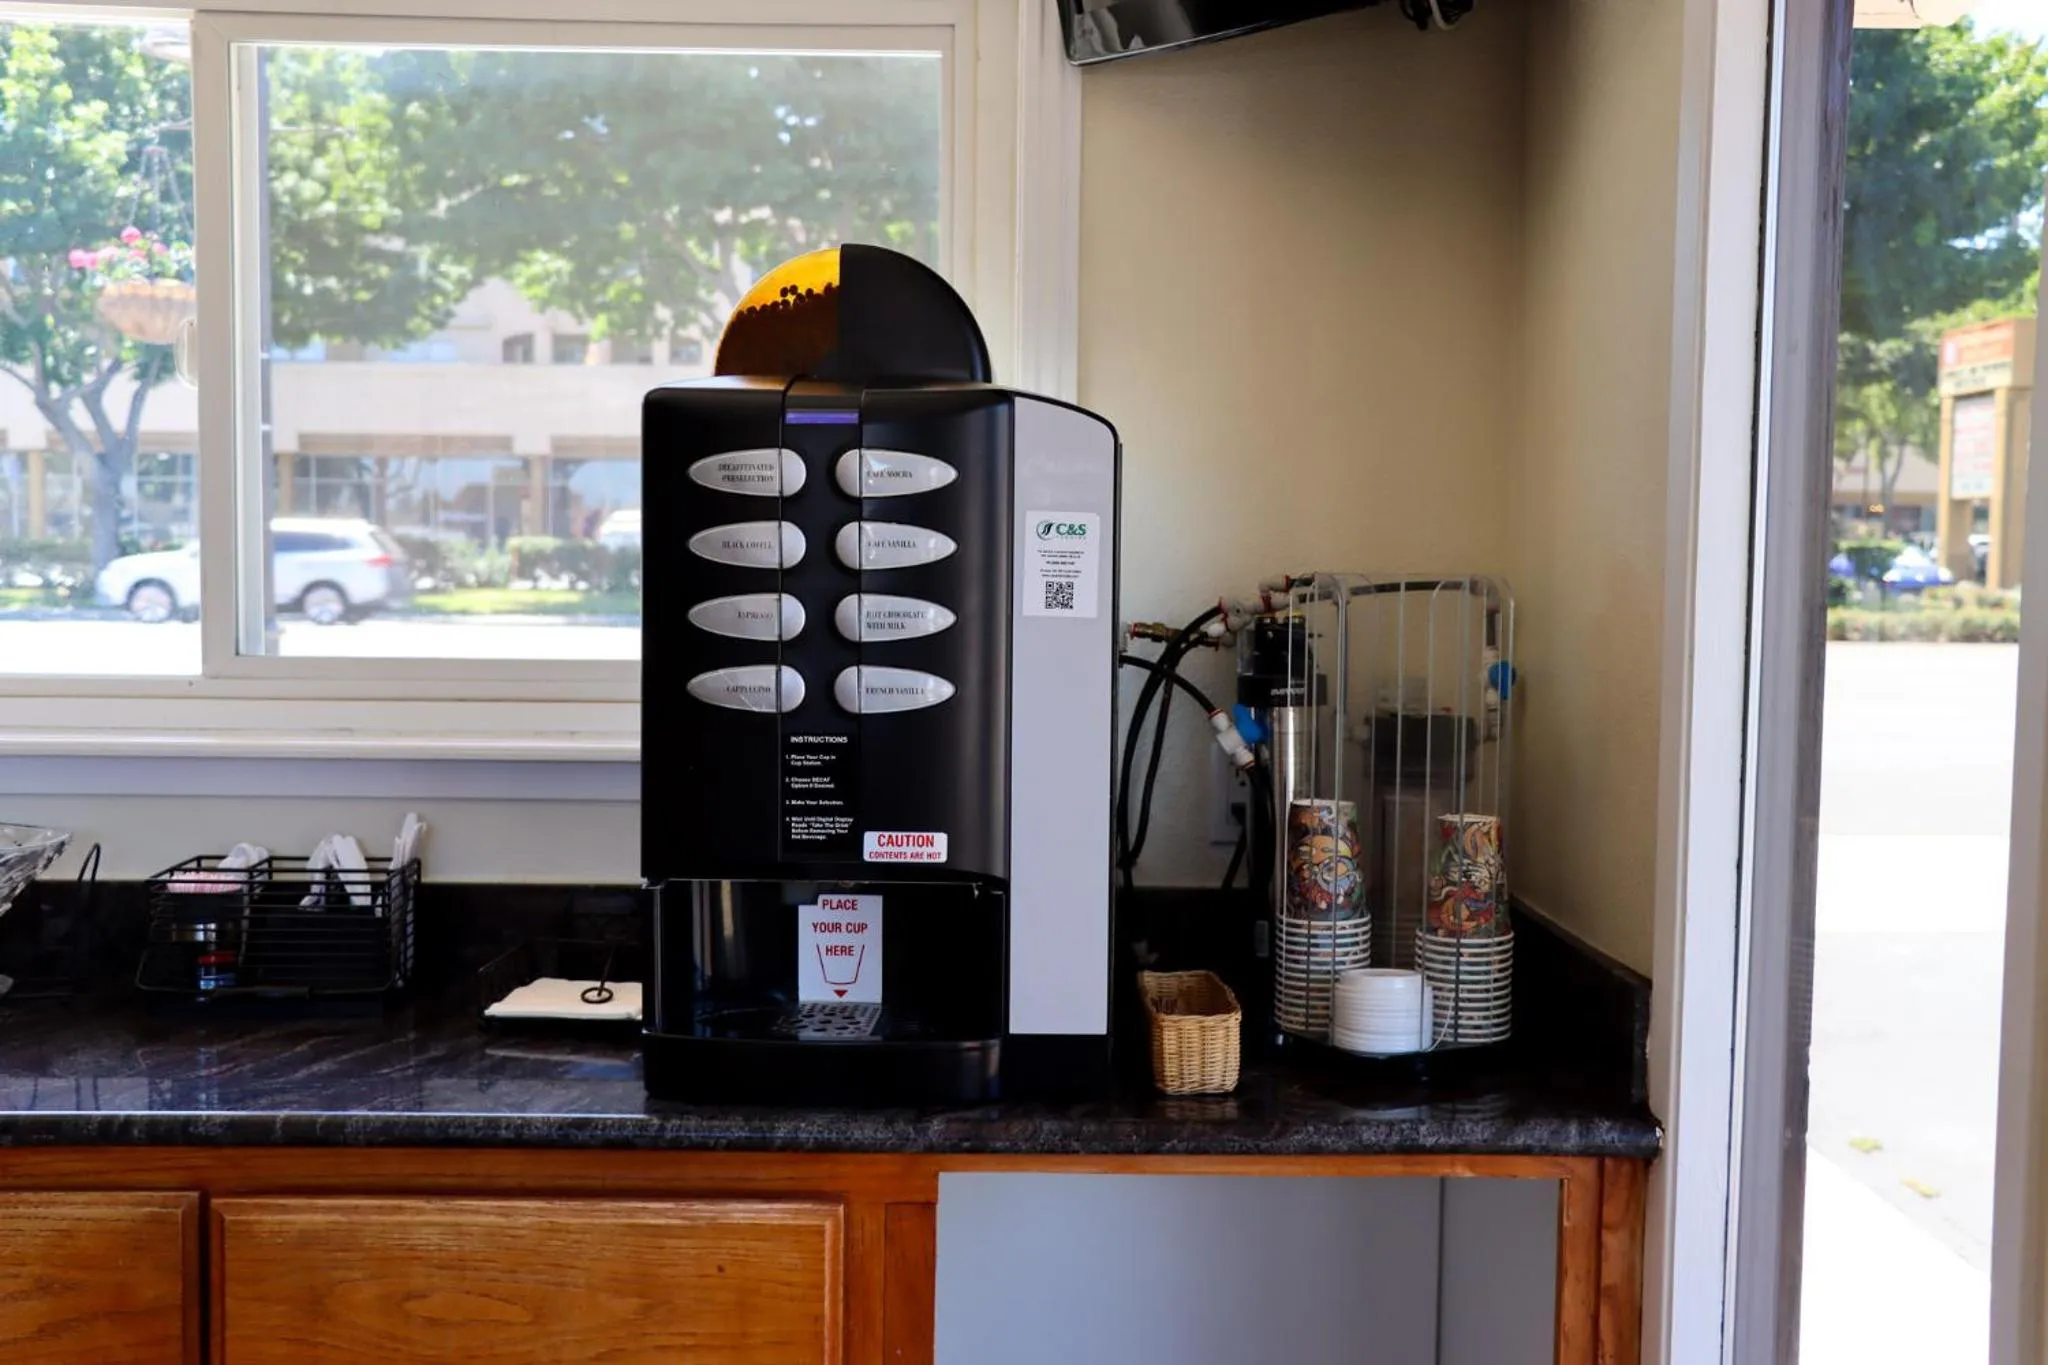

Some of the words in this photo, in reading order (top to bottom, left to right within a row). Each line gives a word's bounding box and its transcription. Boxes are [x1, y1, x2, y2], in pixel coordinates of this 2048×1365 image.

[1055, 523, 1087, 536] C&S
[866, 687, 894, 695] FRENCH
[877, 834, 935, 847] CAUTION
[869, 851, 907, 859] CONTENTS
[910, 851, 924, 860] ARE
[926, 851, 942, 860] HOT
[822, 899, 858, 911] PLACE
[812, 922, 842, 934] YOUR
[845, 922, 868, 935] CUP
[825, 945, 855, 957] HERE
